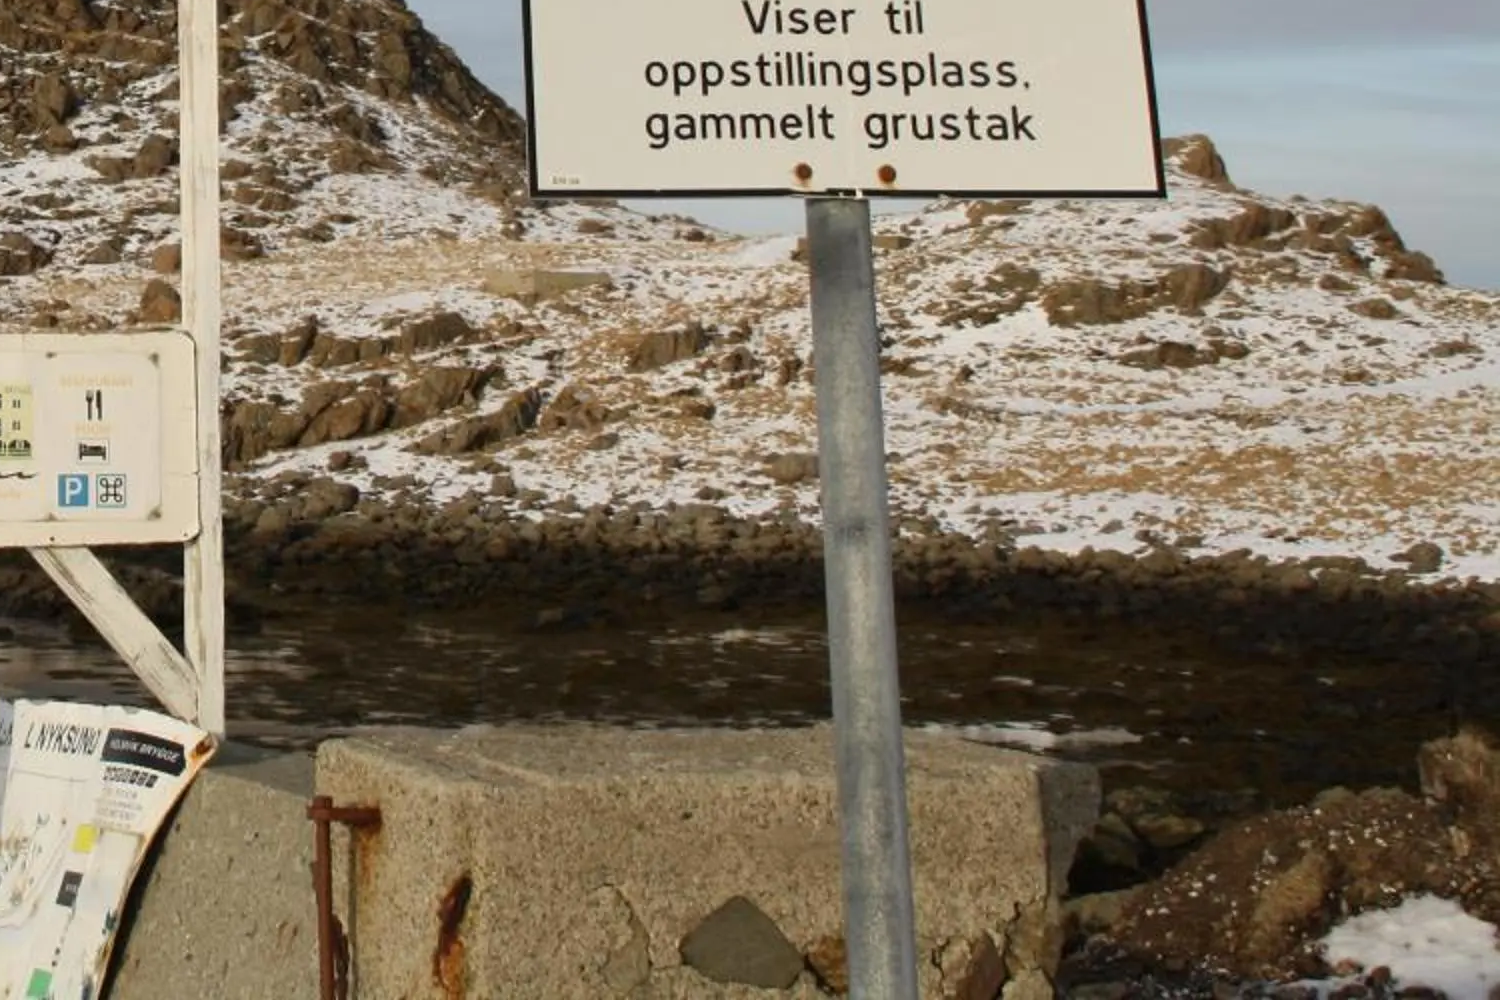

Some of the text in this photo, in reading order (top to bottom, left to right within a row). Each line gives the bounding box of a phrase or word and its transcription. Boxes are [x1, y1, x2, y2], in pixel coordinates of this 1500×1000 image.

[741, 0, 924, 35] Viser til
[645, 103, 1036, 150] gammelt grustak
[65, 478, 82, 505] P
